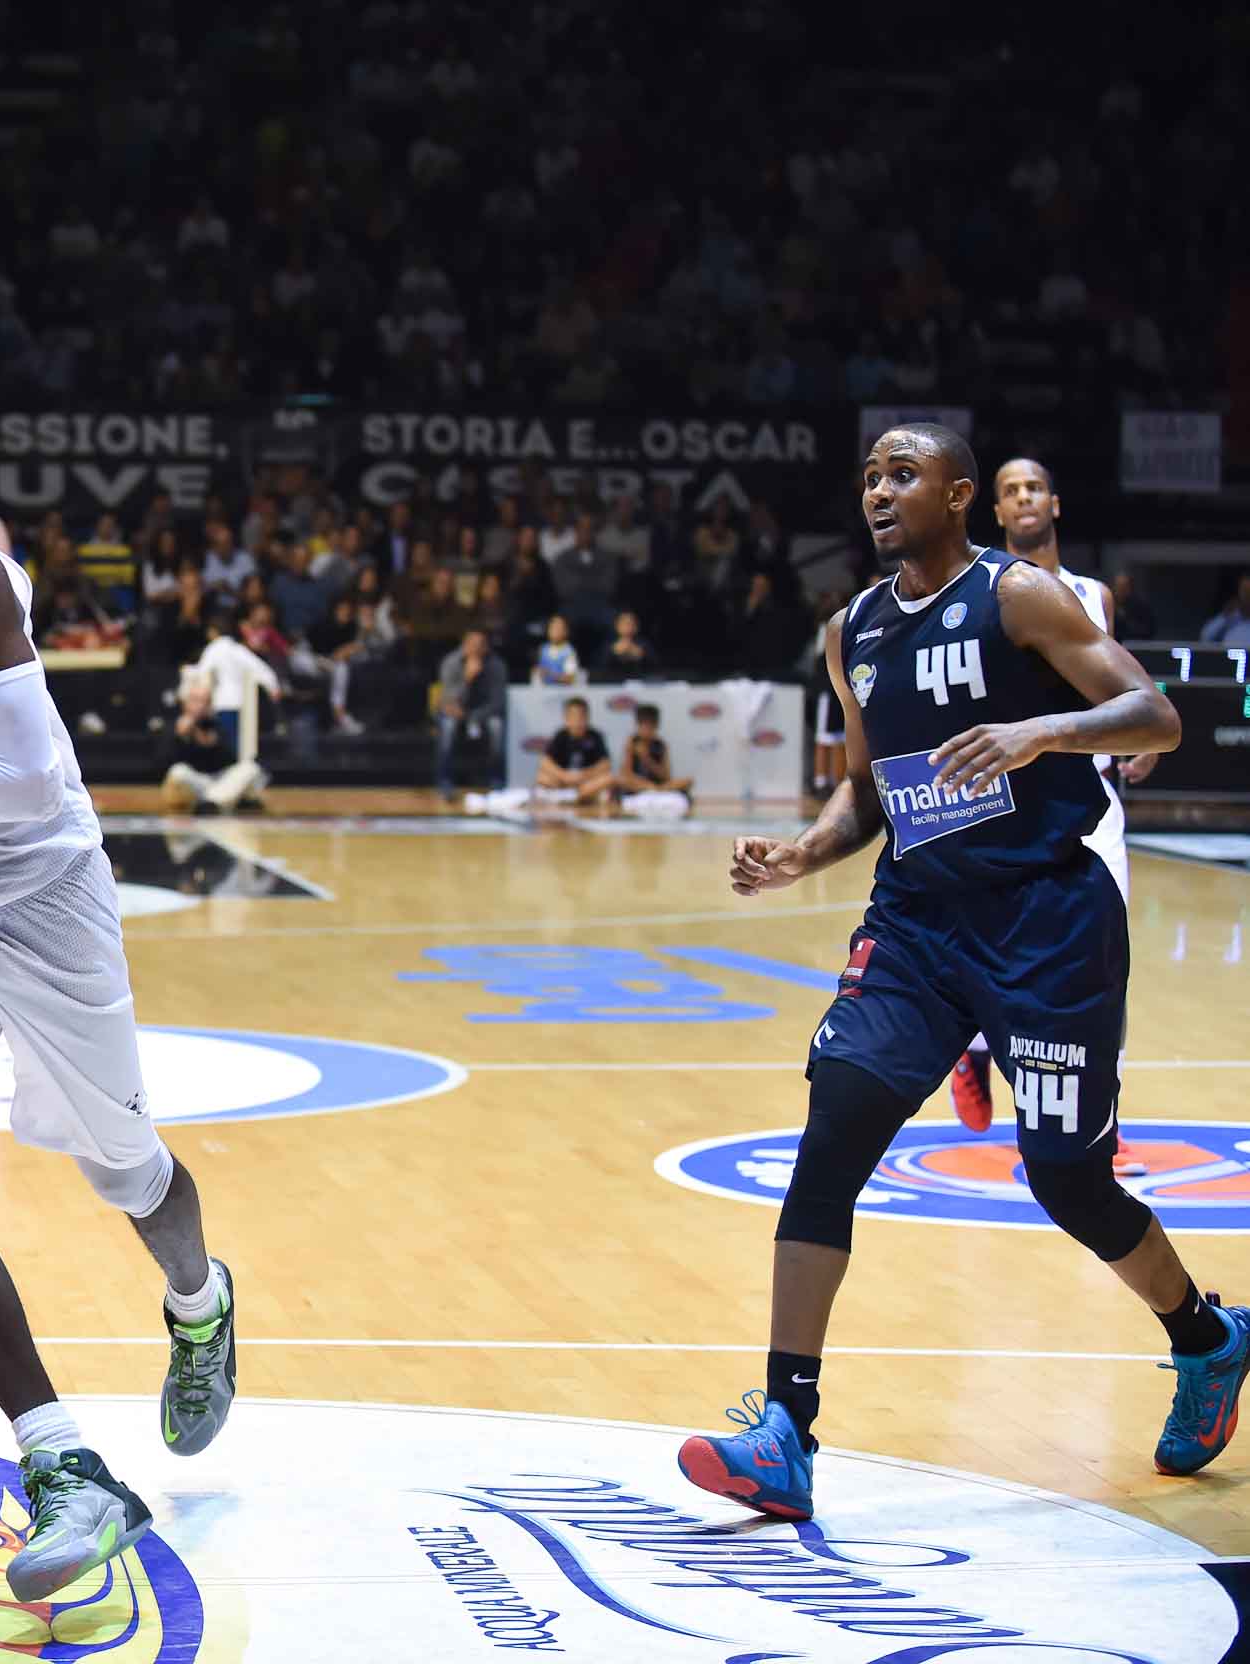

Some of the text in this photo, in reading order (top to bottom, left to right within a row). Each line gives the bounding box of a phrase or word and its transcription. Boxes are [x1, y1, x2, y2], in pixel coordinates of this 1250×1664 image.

[362, 413, 555, 457] STORIA
[916, 638, 988, 706] 44
[911, 798, 1006, 826] facility management
[1009, 1035, 1086, 1068] AUXILIUM
[1014, 1065, 1079, 1134] 44
[407, 1525, 566, 1652] ACQUA MINERALE
